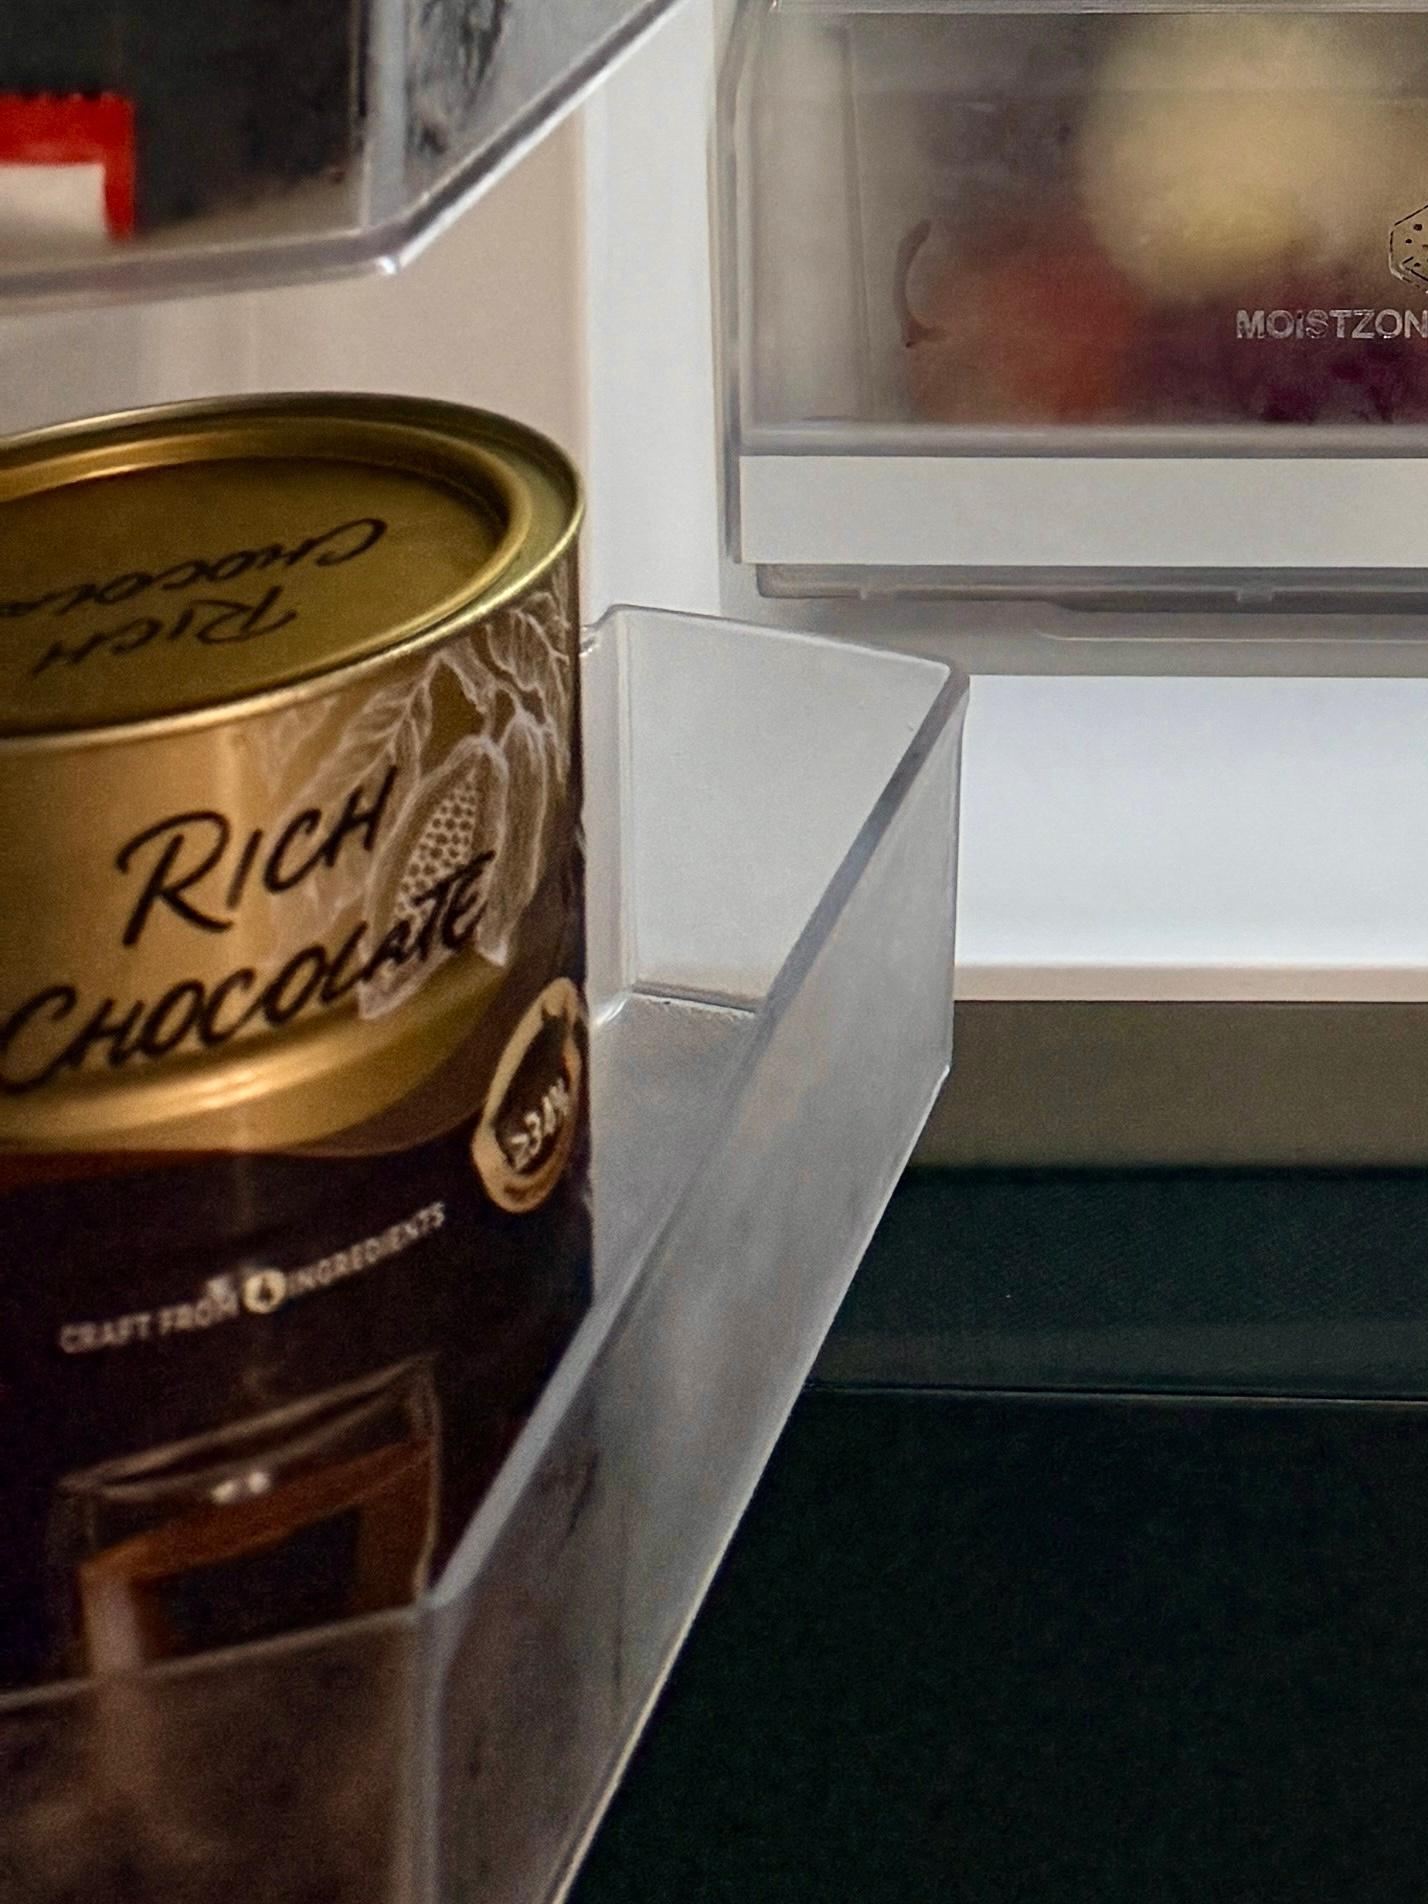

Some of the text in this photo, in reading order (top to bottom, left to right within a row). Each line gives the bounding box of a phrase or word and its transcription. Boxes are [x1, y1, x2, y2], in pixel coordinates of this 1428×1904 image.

[30, 584, 297, 679] RICH
[115, 765, 398, 946] RICH
[0, 849, 496, 1091] CHOCOLATE
[59, 1311, 151, 1355] CRAFT
[158, 1275, 241, 1336] FROM
